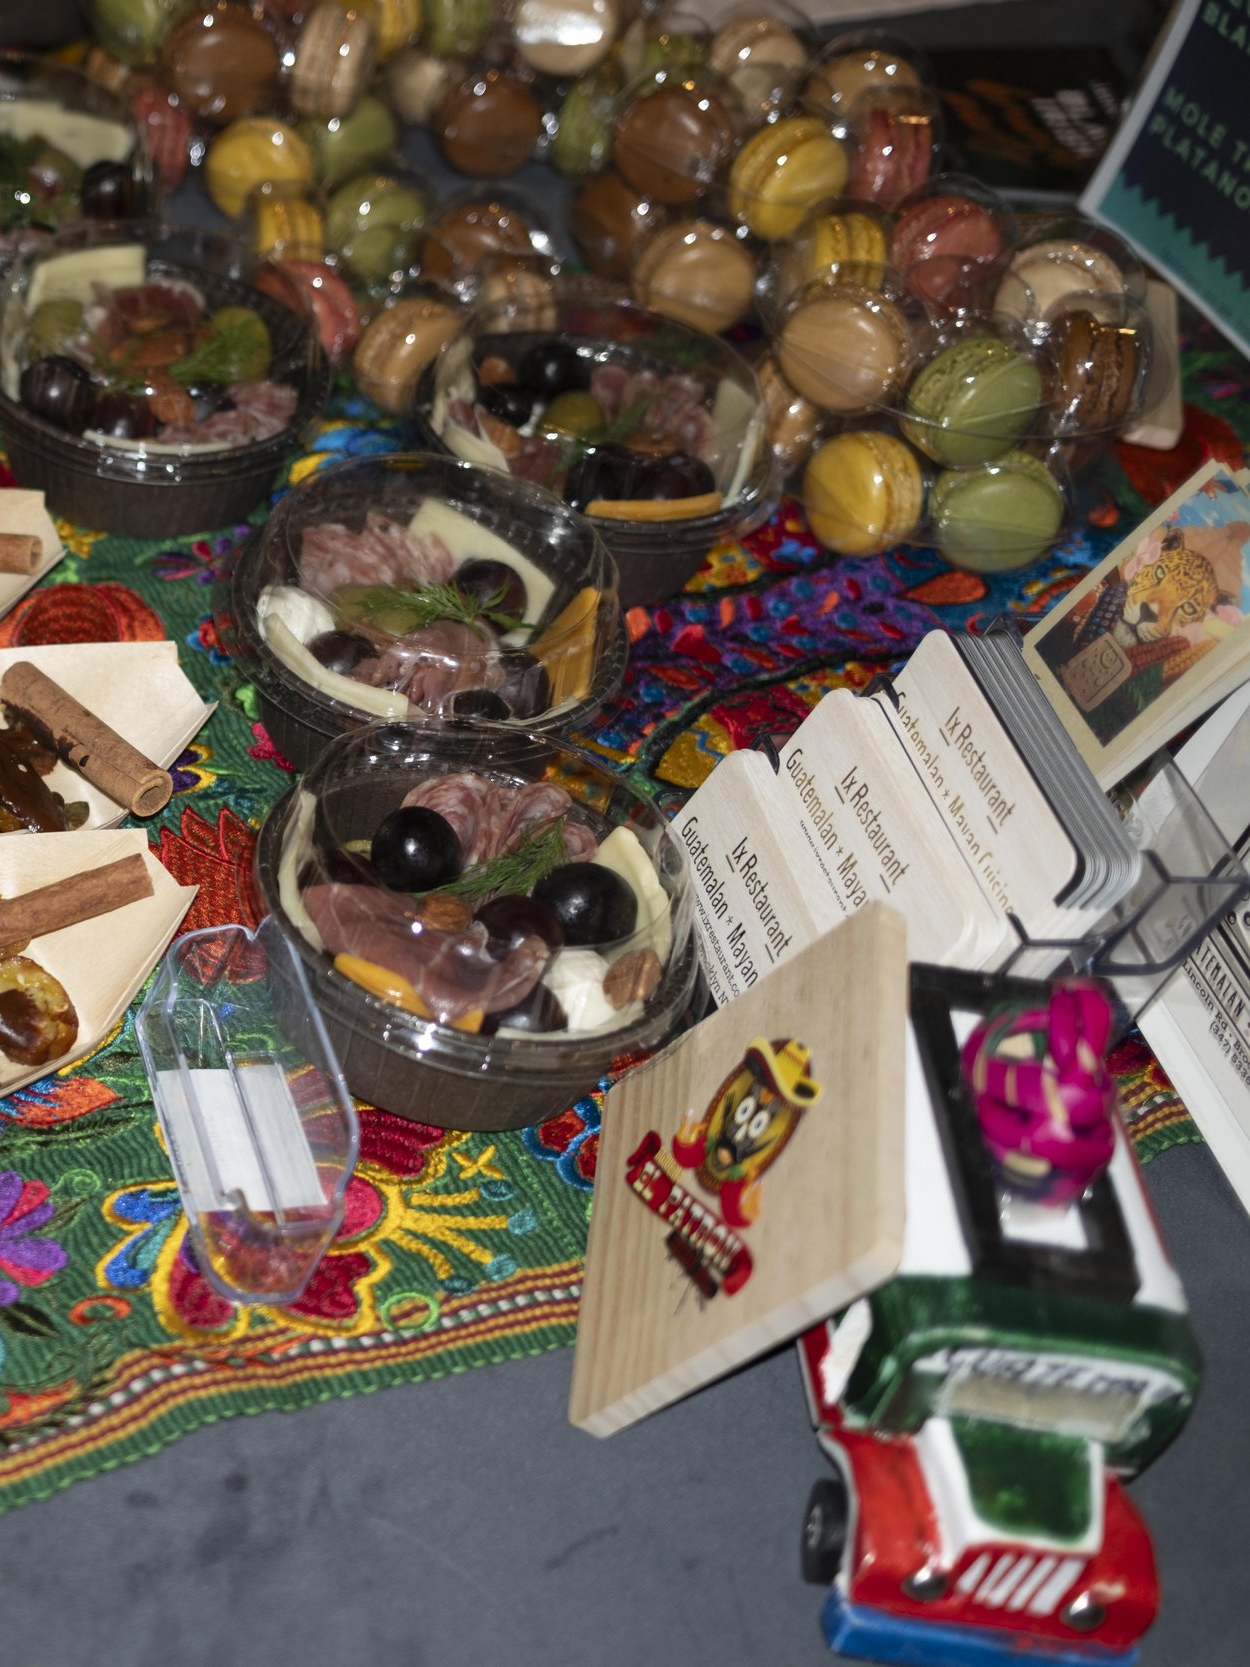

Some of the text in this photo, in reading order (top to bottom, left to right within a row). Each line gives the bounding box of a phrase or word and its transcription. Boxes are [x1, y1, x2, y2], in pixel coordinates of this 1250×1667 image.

[1203, 2, 1250, 55] BLA
[1163, 86, 1228, 149] MOLE
[1232, 139, 1250, 172] T
[955, 724, 1015, 826] Restaurant
[786, 748, 869, 908] Guatemalan Maya
[850, 783, 909, 885] Restaurant
[682, 816, 758, 988] Guatemalan Mayan
[739, 854, 793, 957] Restaurant
[1182, 960, 1214, 1011] Lincoln
[1215, 1011, 1228, 1030] Rd
[1210, 1021, 1232, 1054] (347)
[633, 1160, 661, 1200] EL
